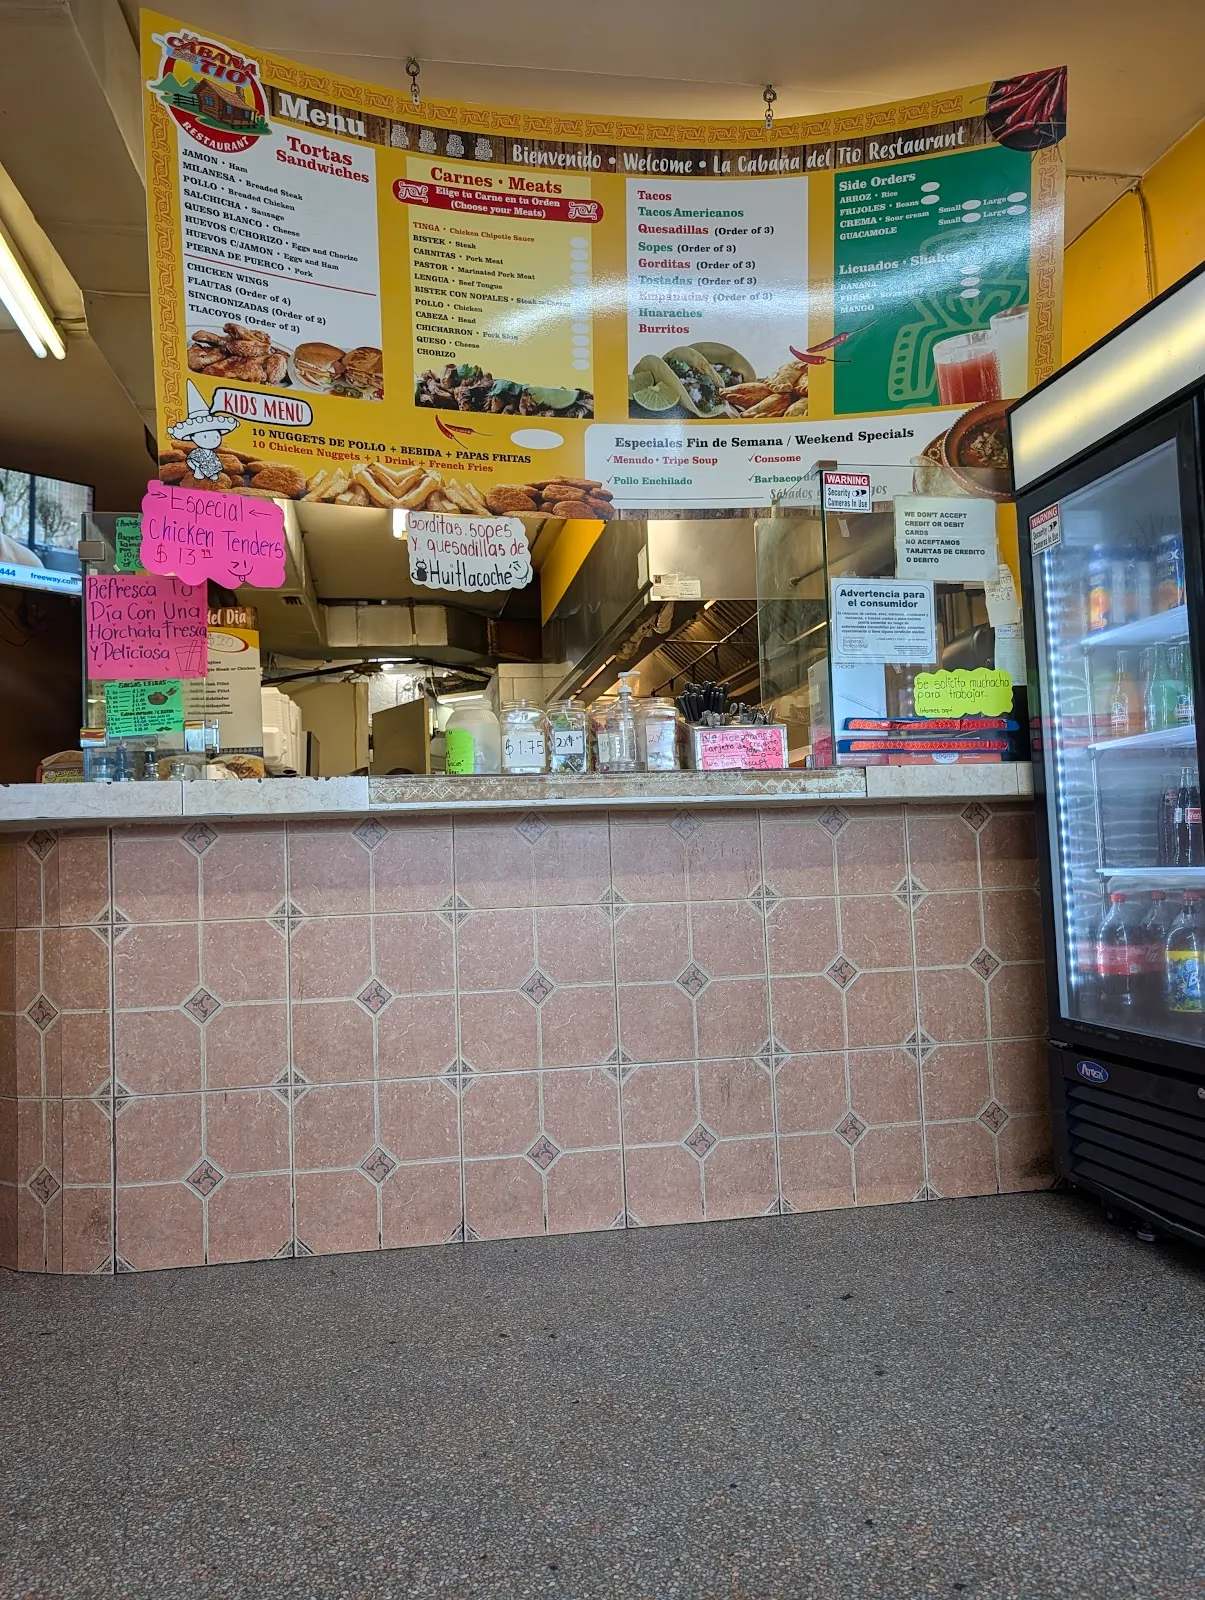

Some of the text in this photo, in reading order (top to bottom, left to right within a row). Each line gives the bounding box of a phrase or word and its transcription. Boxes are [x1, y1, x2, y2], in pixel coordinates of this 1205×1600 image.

[201, 60, 246, 84] TIO
[279, 92, 367, 138] Menu
[182, 121, 250, 152] RESTAURANT
[286, 136, 353, 165] Tortas
[512, 126, 966, 174] Bienvenido Welcome La Cabaña del Tio Restaurant
[182, 149, 248, 173] JAMON Ham
[276, 150, 369, 184] Sandwiches
[182, 162, 303, 201] MILANESA Breaded Steak
[430, 167, 562, 194] Carnes Meats
[839, 172, 916, 192] Side Orders
[183, 174, 295, 211] POLLO Breaded Chicken
[435, 187, 560, 208] Elige tu Carne en tu Orden
[637, 190, 672, 201] Tacos
[839, 190, 898, 204] ARROZ Rice
[183, 188, 285, 222] SALCHICHA Sausage
[450, 200, 547, 219] (Choose your Meats)
[637, 206, 744, 218] Tacos Americanos
[839, 203, 886, 216] FRIJOLES
[184, 201, 301, 238] QUESO BLANCO Cheese
[637, 223, 775, 237] Quesadillas (Order of 3)
[839, 226, 897, 241] GUACAMOLE
[413, 234, 476, 249] BISTEK Steak
[637, 242, 737, 254] Sopes (Order of 3)
[186, 241, 314, 278] PIERNA DE PUERCO Pork
[413, 247, 504, 265] CARNITAS Pork Meat
[187, 262, 269, 288] CHICKEN WINGS
[839, 259, 899, 275] Licuados
[414, 272, 449, 284] LENGUA
[187, 275, 292, 308] FLAUTAS (Order of 4)
[415, 298, 483, 313] POLLO Chicken
[415, 311, 476, 325] CABEZA Head
[638, 323, 690, 334] Burritos
[416, 335, 447, 347] QUESO
[416, 347, 456, 358] CHORIZO
[223, 393, 304, 423] KIDS MENU
[252, 428, 532, 464] 10 NUGGETS DE POLLO BEBIDA PAPAS FRITAS
[615, 427, 914, 451] Especiales Fin de Semana Weekend Specials
[613, 455, 718, 467] Menudo Tripe Soup
[754, 453, 801, 464] Consome
[613, 475, 693, 486] Pollo Enchilado
[826, 474, 868, 486] WARNING
[827, 487, 851, 498] Security
[171, 487, 243, 525] Especial
[827, 497, 851, 508] Cameras
[858, 499, 868, 508] Use
[917, 511, 938, 519] DON'T
[149, 515, 284, 559] Chicken Tenders
[427, 537, 506, 560] quesadillas
[510, 538, 526, 556] de
[30, 572, 79, 586] freeway.com
[429, 559, 513, 587] Huitlacoche
[88, 576, 157, 599] Refresca
[840, 588, 925, 600] Advertencia para
[127, 603, 156, 621] Con
[164, 601, 200, 620] Una
[848, 598, 918, 609] el consumidor
[89, 620, 161, 641] Horchata
[103, 641, 170, 661] Deliciosa
[917, 691, 940, 704] para
[519, 739, 545, 756] 1.75
